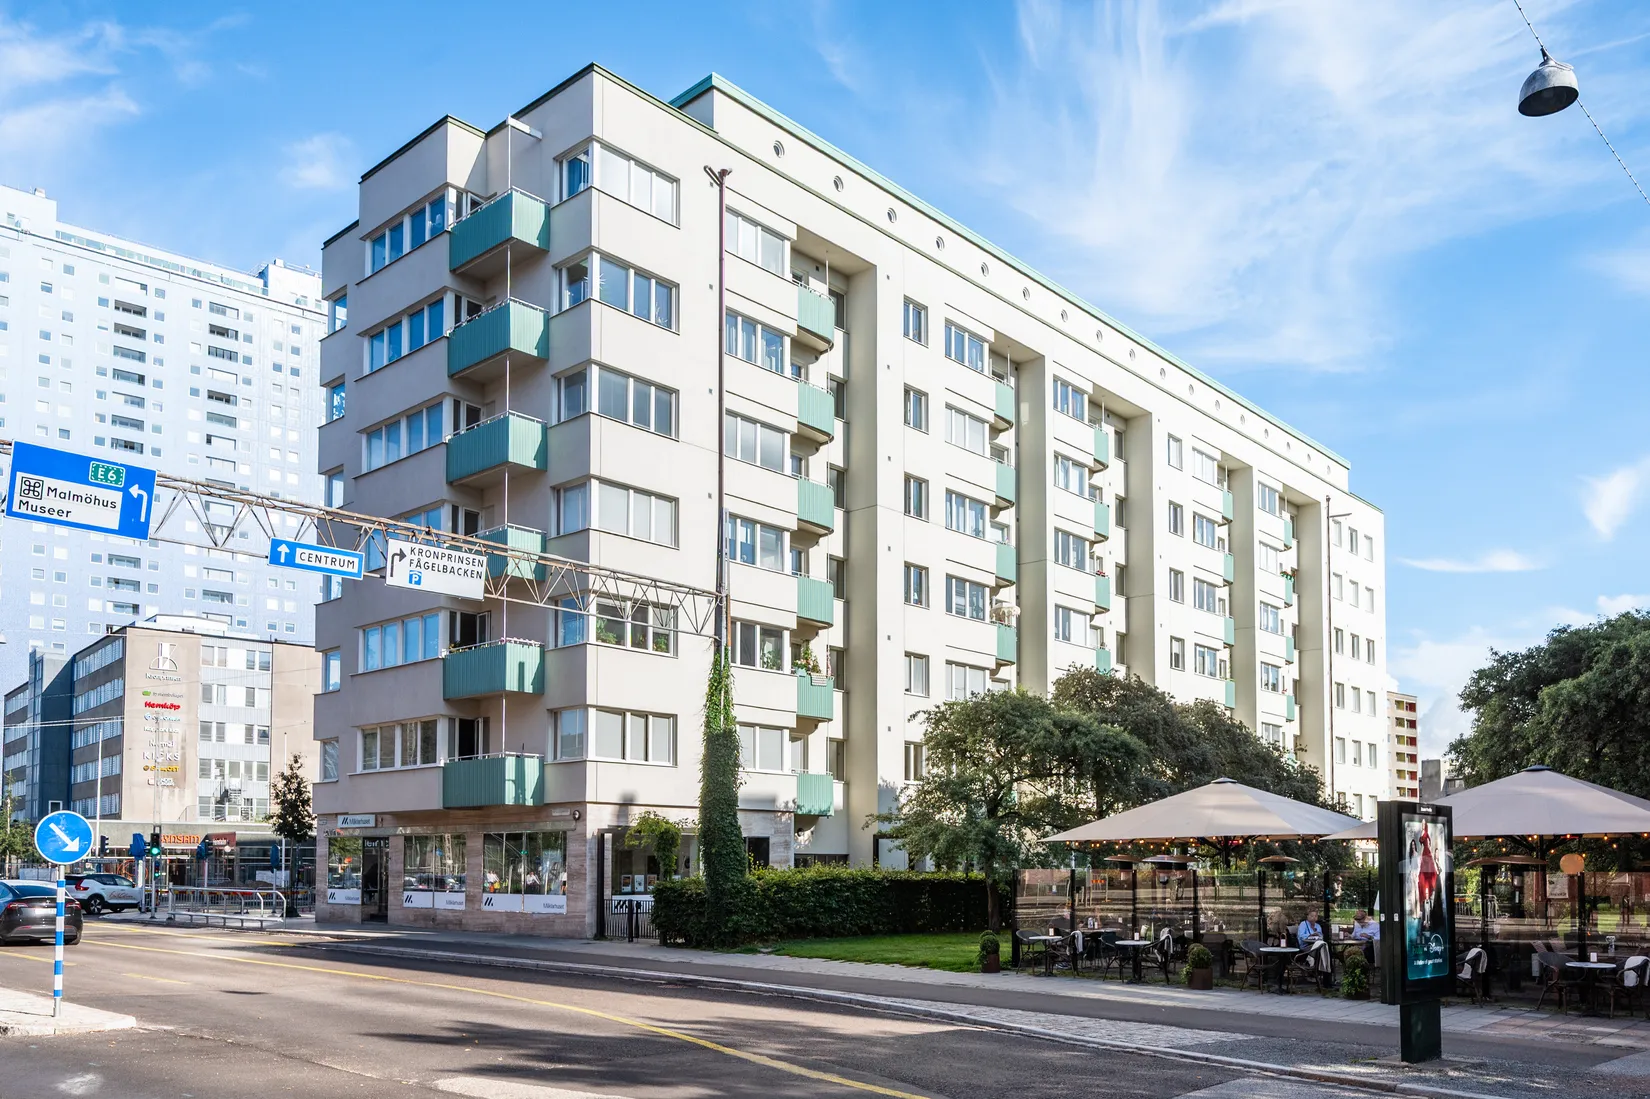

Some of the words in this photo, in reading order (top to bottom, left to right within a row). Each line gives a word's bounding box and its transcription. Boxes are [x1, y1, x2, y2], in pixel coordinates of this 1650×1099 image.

[97, 466, 118, 482] E6
[46, 485, 118, 510] Malmöhus
[18, 499, 72, 518] Museer
[299, 551, 356, 570] CENTRUM
[409, 546, 485, 569] KRONPRINSEN
[409, 557, 483, 580] FÅGELBACKEN
[144, 701, 181, 711] Hemköp
